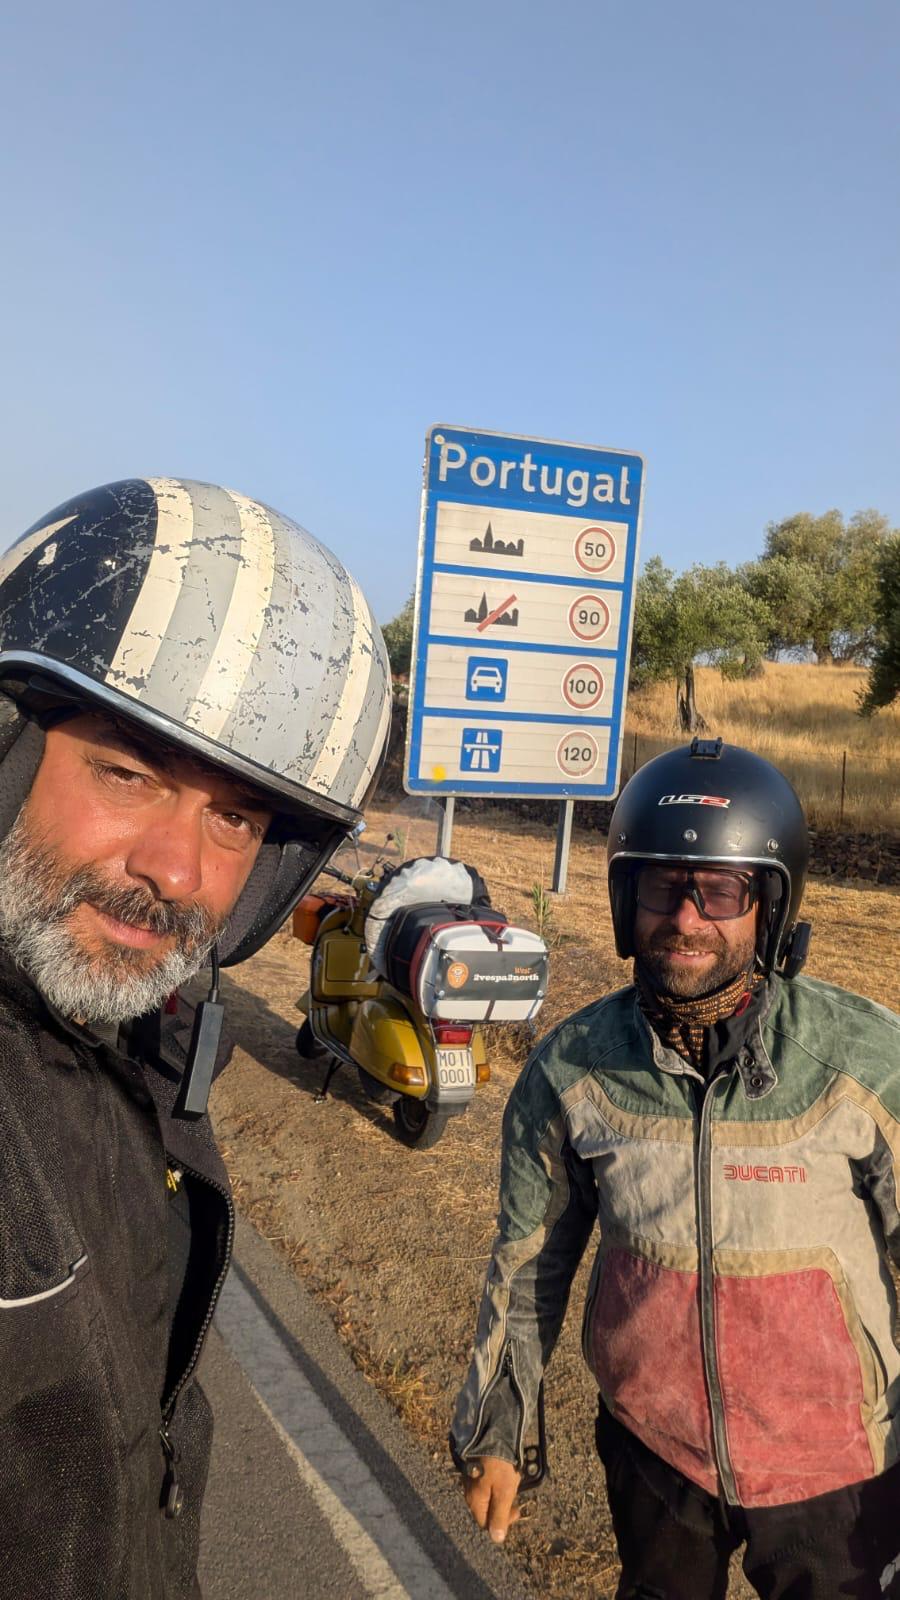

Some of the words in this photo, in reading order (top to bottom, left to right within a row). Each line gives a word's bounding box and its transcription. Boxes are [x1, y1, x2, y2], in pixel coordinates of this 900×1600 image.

[439, 442, 631, 507] Portugal
[584, 542, 606, 558] 50
[578, 609, 600, 626] 90
[569, 679, 598, 695] 100
[564, 747, 592, 762] 120
[723, 1164, 806, 1183] DUCATI
